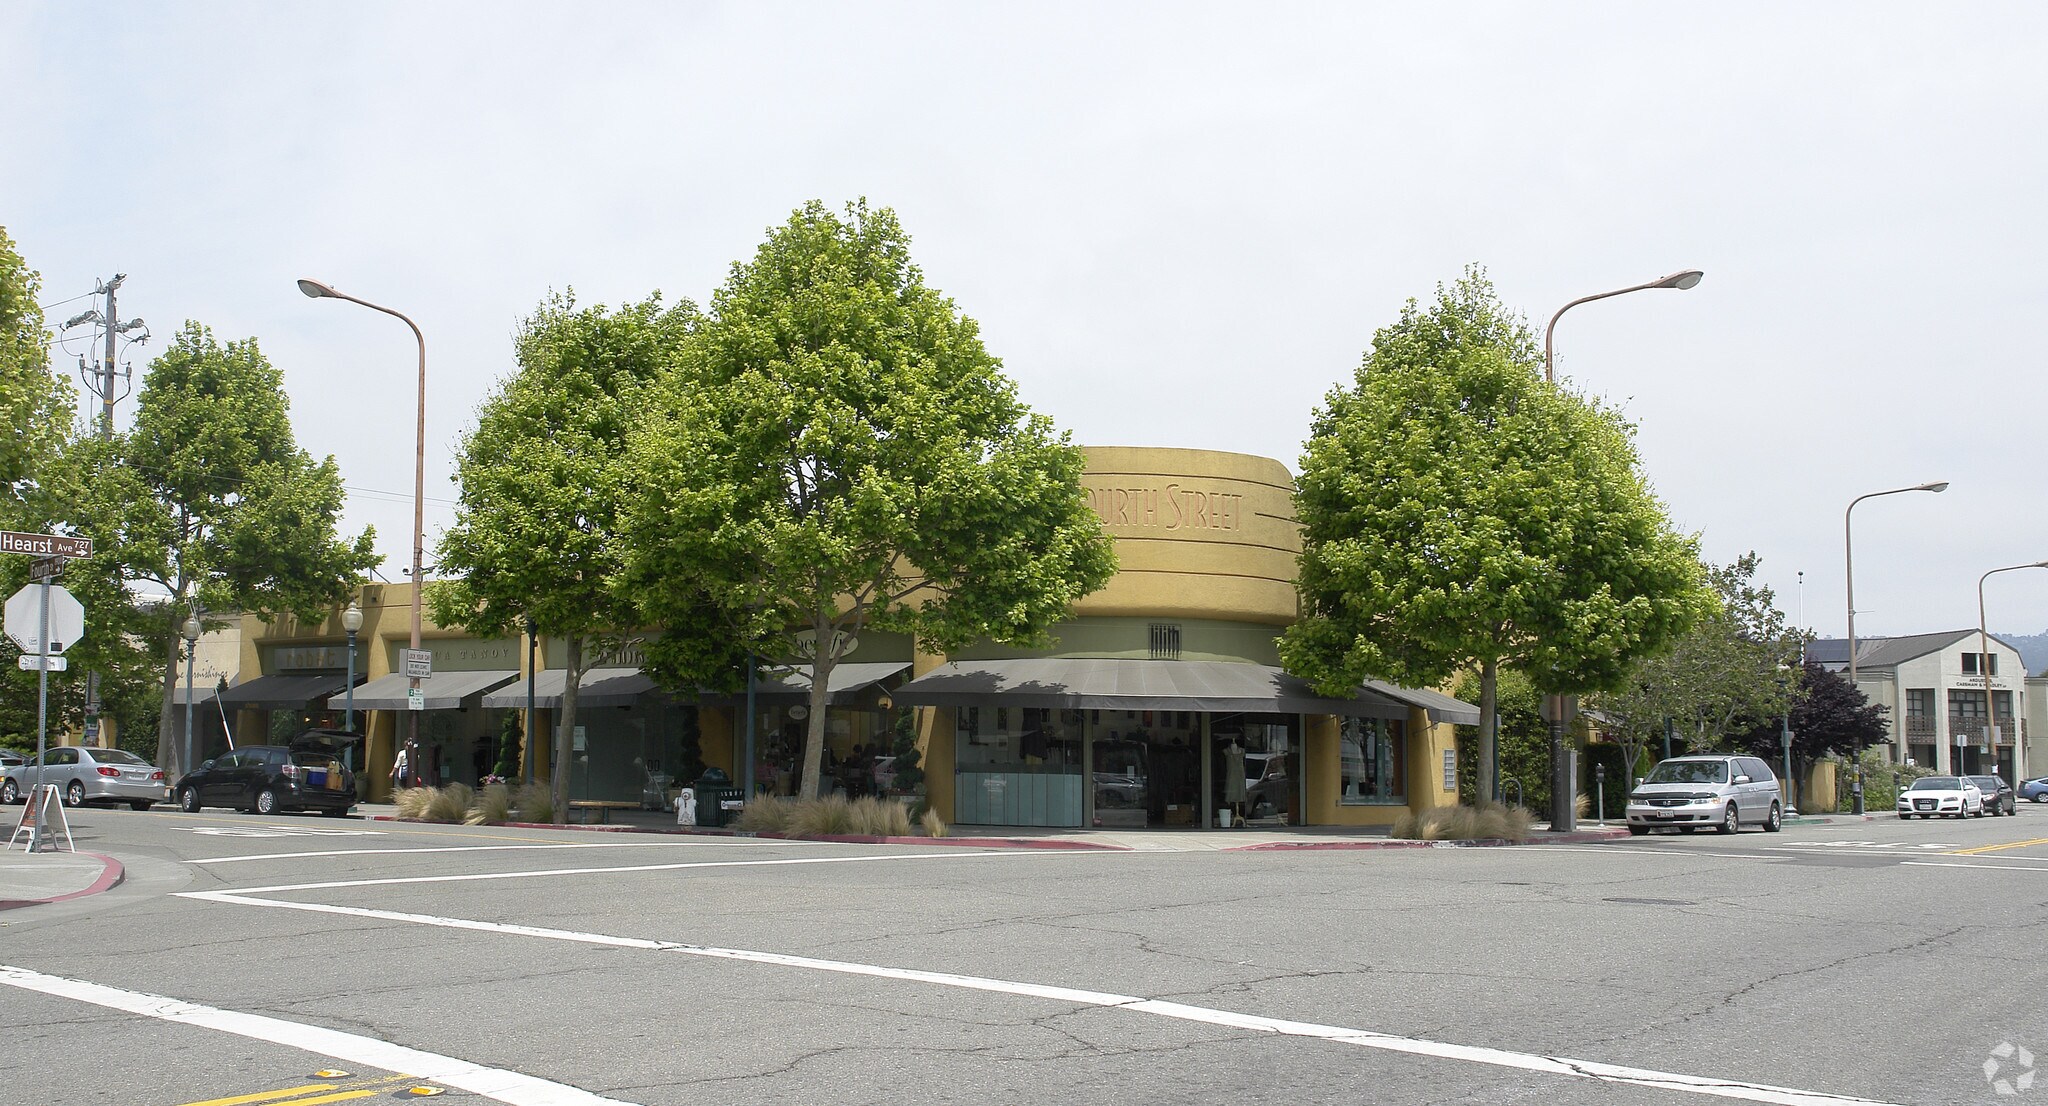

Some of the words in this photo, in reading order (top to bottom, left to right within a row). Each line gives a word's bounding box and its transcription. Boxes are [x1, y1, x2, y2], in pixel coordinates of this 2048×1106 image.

[3, 534, 53, 553] Hearst
[57, 543, 73, 552] Ave
[74, 540, 90, 549] 727
[32, 560, 50, 578] Fourth
